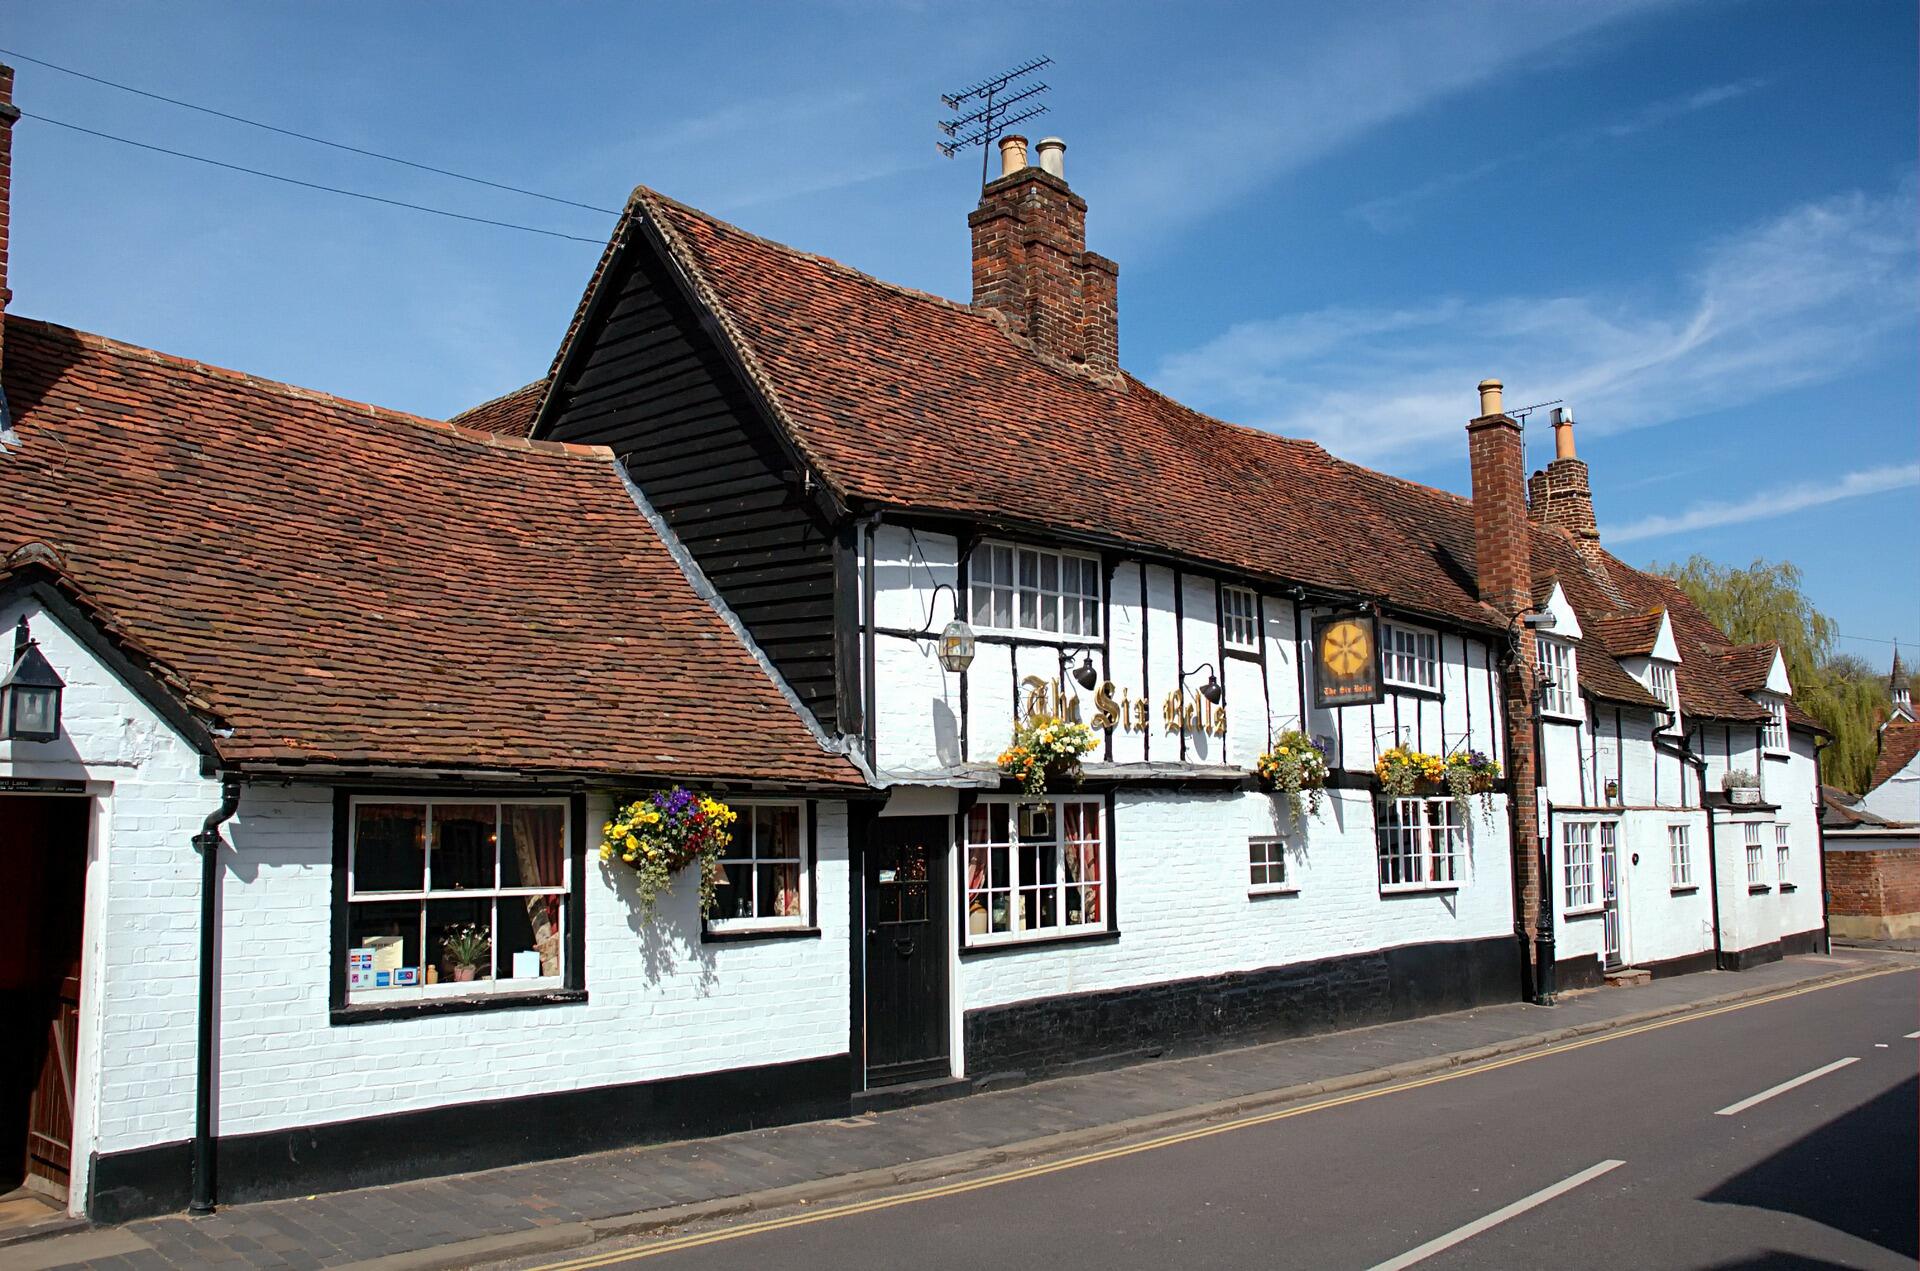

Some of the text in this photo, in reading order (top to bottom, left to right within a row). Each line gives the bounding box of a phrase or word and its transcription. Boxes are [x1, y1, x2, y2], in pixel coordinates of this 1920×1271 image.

[1323, 684, 1373, 696] The Six Bells
[1091, 680, 1150, 733] Six
[1163, 688, 1227, 735] Bells
